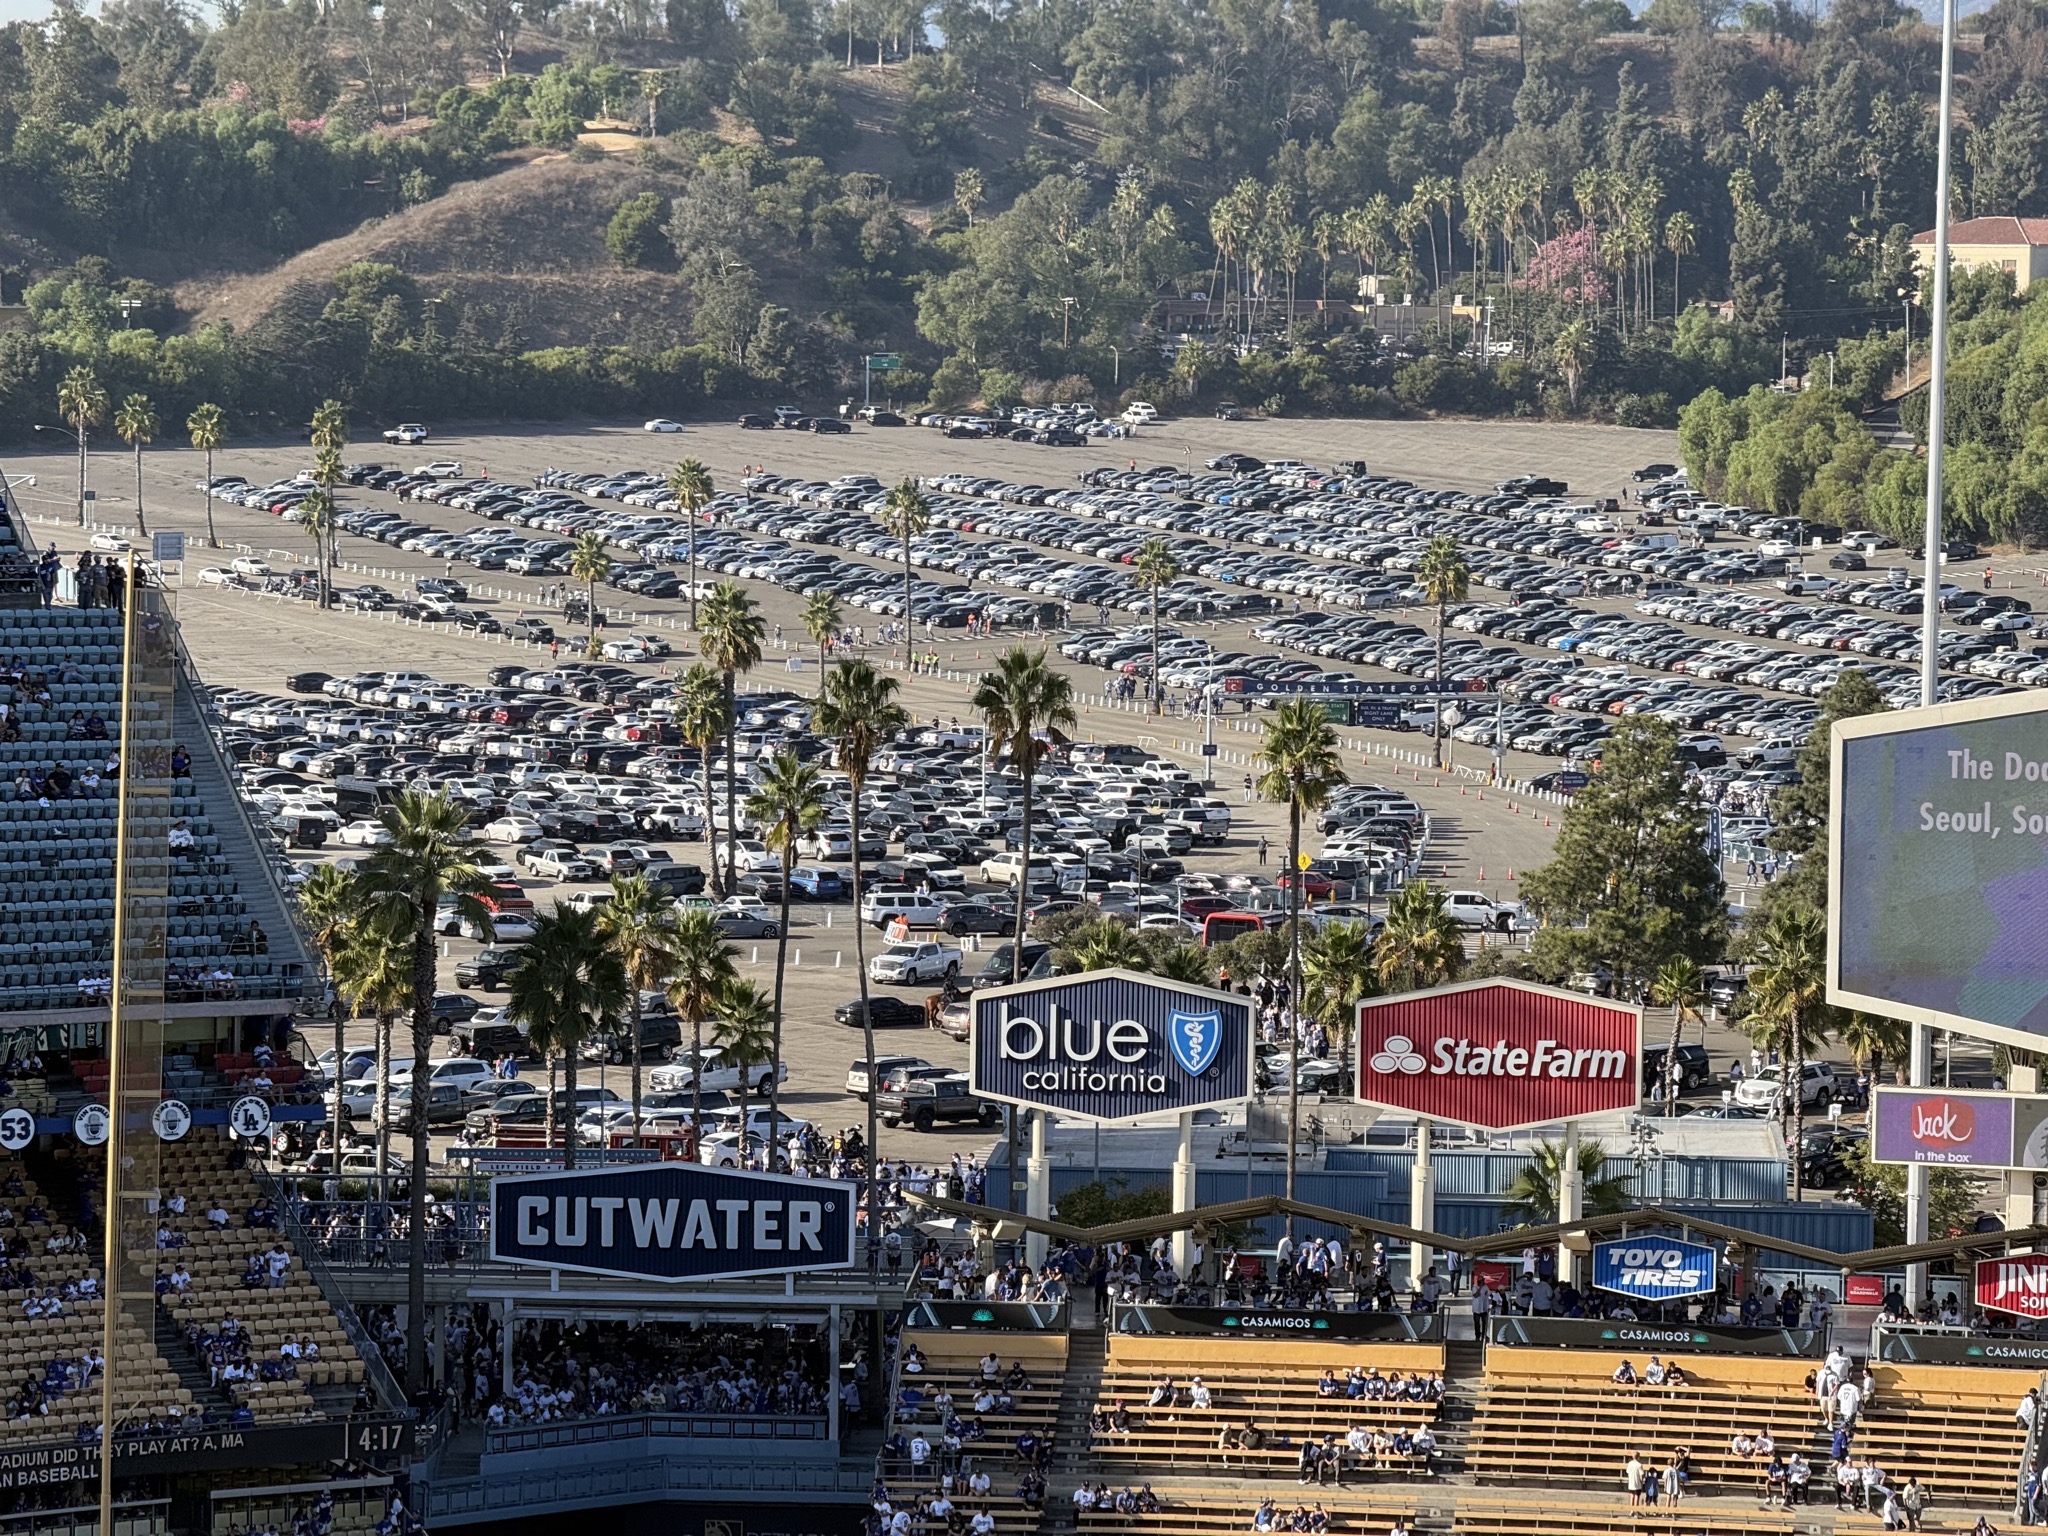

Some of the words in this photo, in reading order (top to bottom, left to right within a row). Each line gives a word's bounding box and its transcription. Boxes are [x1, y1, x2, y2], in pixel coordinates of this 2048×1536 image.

[1230, 683, 1237, 691] C
[1256, 683, 1330, 693] GOLDEN
[1343, 684, 1396, 693] STATE
[1409, 684, 1454, 692] GATE
[1947, 748, 1994, 780] The
[1920, 801, 2001, 839] Seoul,
[2012, 804, 2048, 835] So
[1000, 1002, 1149, 1063] blue
[1022, 1066, 1166, 1093] california
[77, 1109, 89, 1121] VIN
[243, 1108, 259, 1131] LA
[1912, 1102, 1973, 1142] Jack
[1, 1116, 31, 1142] 53
[1927, 1151, 1946, 1162] the
[1948, 1152, 1970, 1163] box
[1608, 1248, 1683, 1268] TOYO
[1620, 1268, 1701, 1288] TIRES
[2020, 1295, 2048, 1311] SOJ
[1241, 1315, 1311, 1330] CASAMIGOS
[1619, 1329, 1691, 1343] CASAMIGOS
[359, 1424, 403, 1451] 4:17
[0, 1450, 49, 1470] ADIUM
[53, 1448, 79, 1464] DID
[128, 1441, 168, 1457] PLAY
[170, 1437, 199, 1453] AT?
[202, 1435, 218, 1451] A,
[221, 1432, 245, 1449] MA
[914, 1444, 920, 1454] 5
[18, 1465, 99, 1487] BASEBALL
